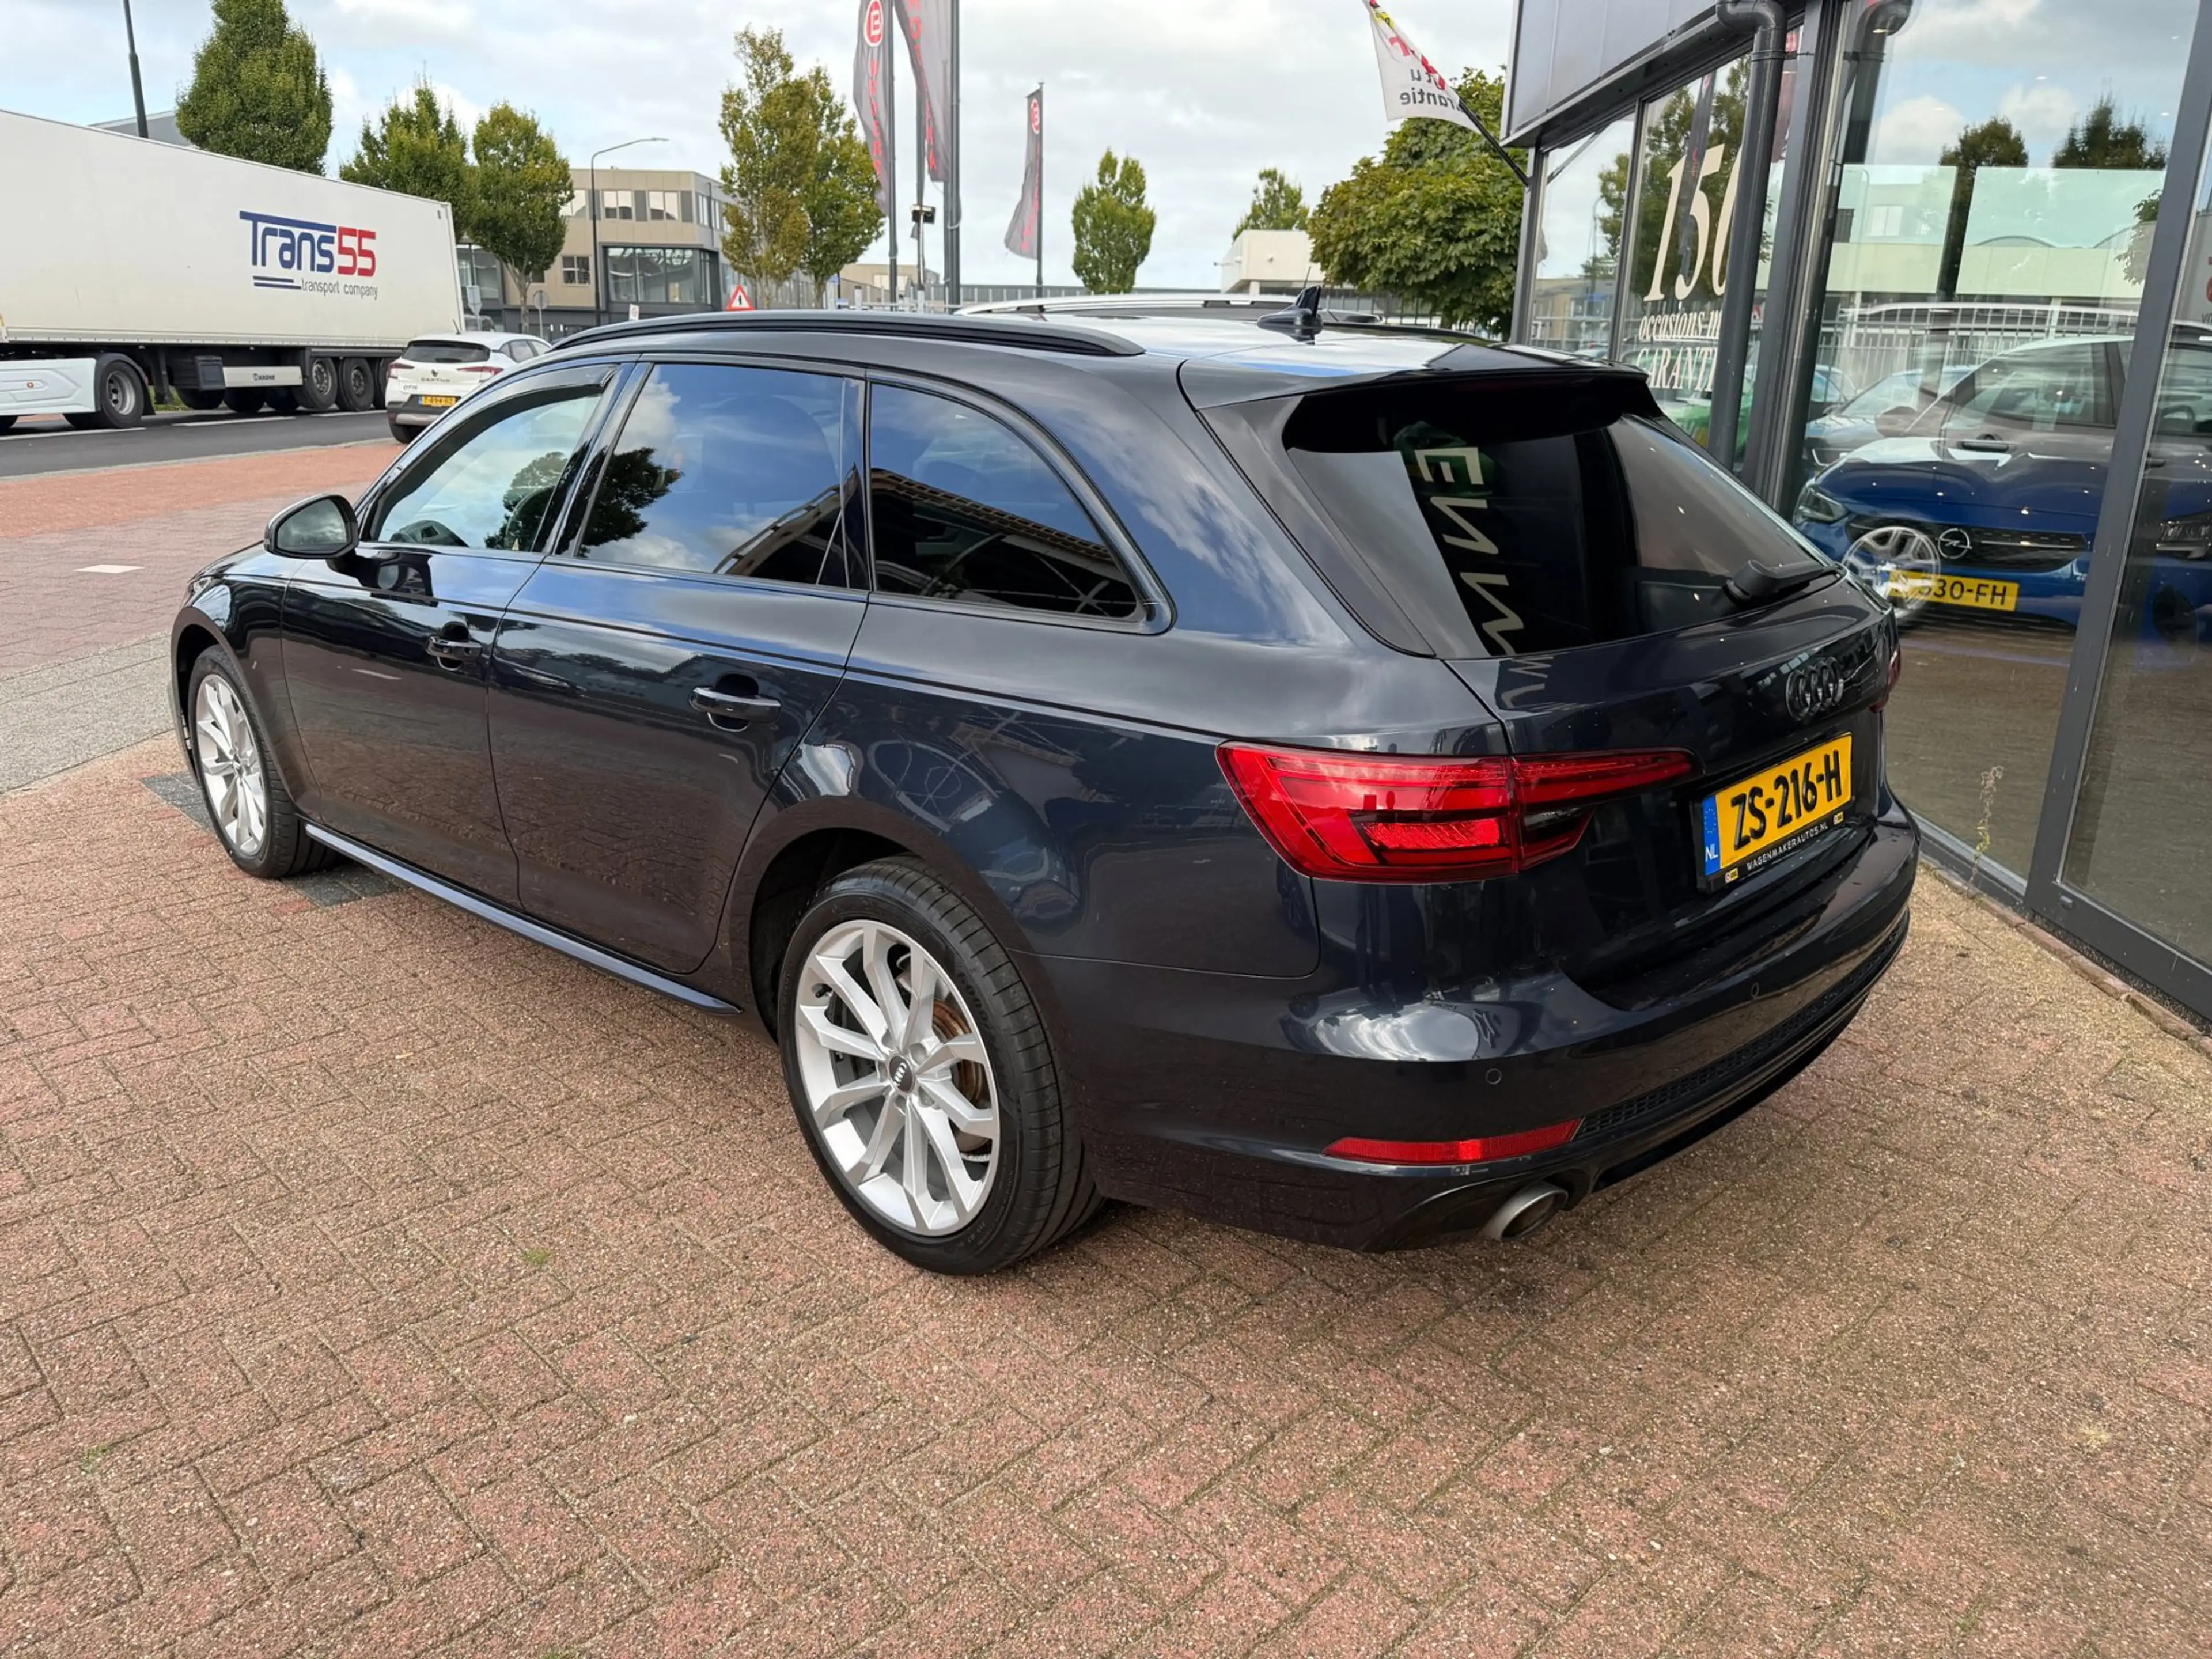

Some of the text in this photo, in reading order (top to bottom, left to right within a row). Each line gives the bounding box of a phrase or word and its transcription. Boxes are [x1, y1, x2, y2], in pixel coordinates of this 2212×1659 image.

[301, 278, 378, 300] transport company
[1638, 311, 1705, 341] occasions
[1636, 346, 1717, 392] ARANTI
[1730, 749, 1842, 851] ZS-216-H
[1705, 843, 1719, 861] NL
[1746, 822, 1829, 871] WAGENMAKERAUTOS.NL
